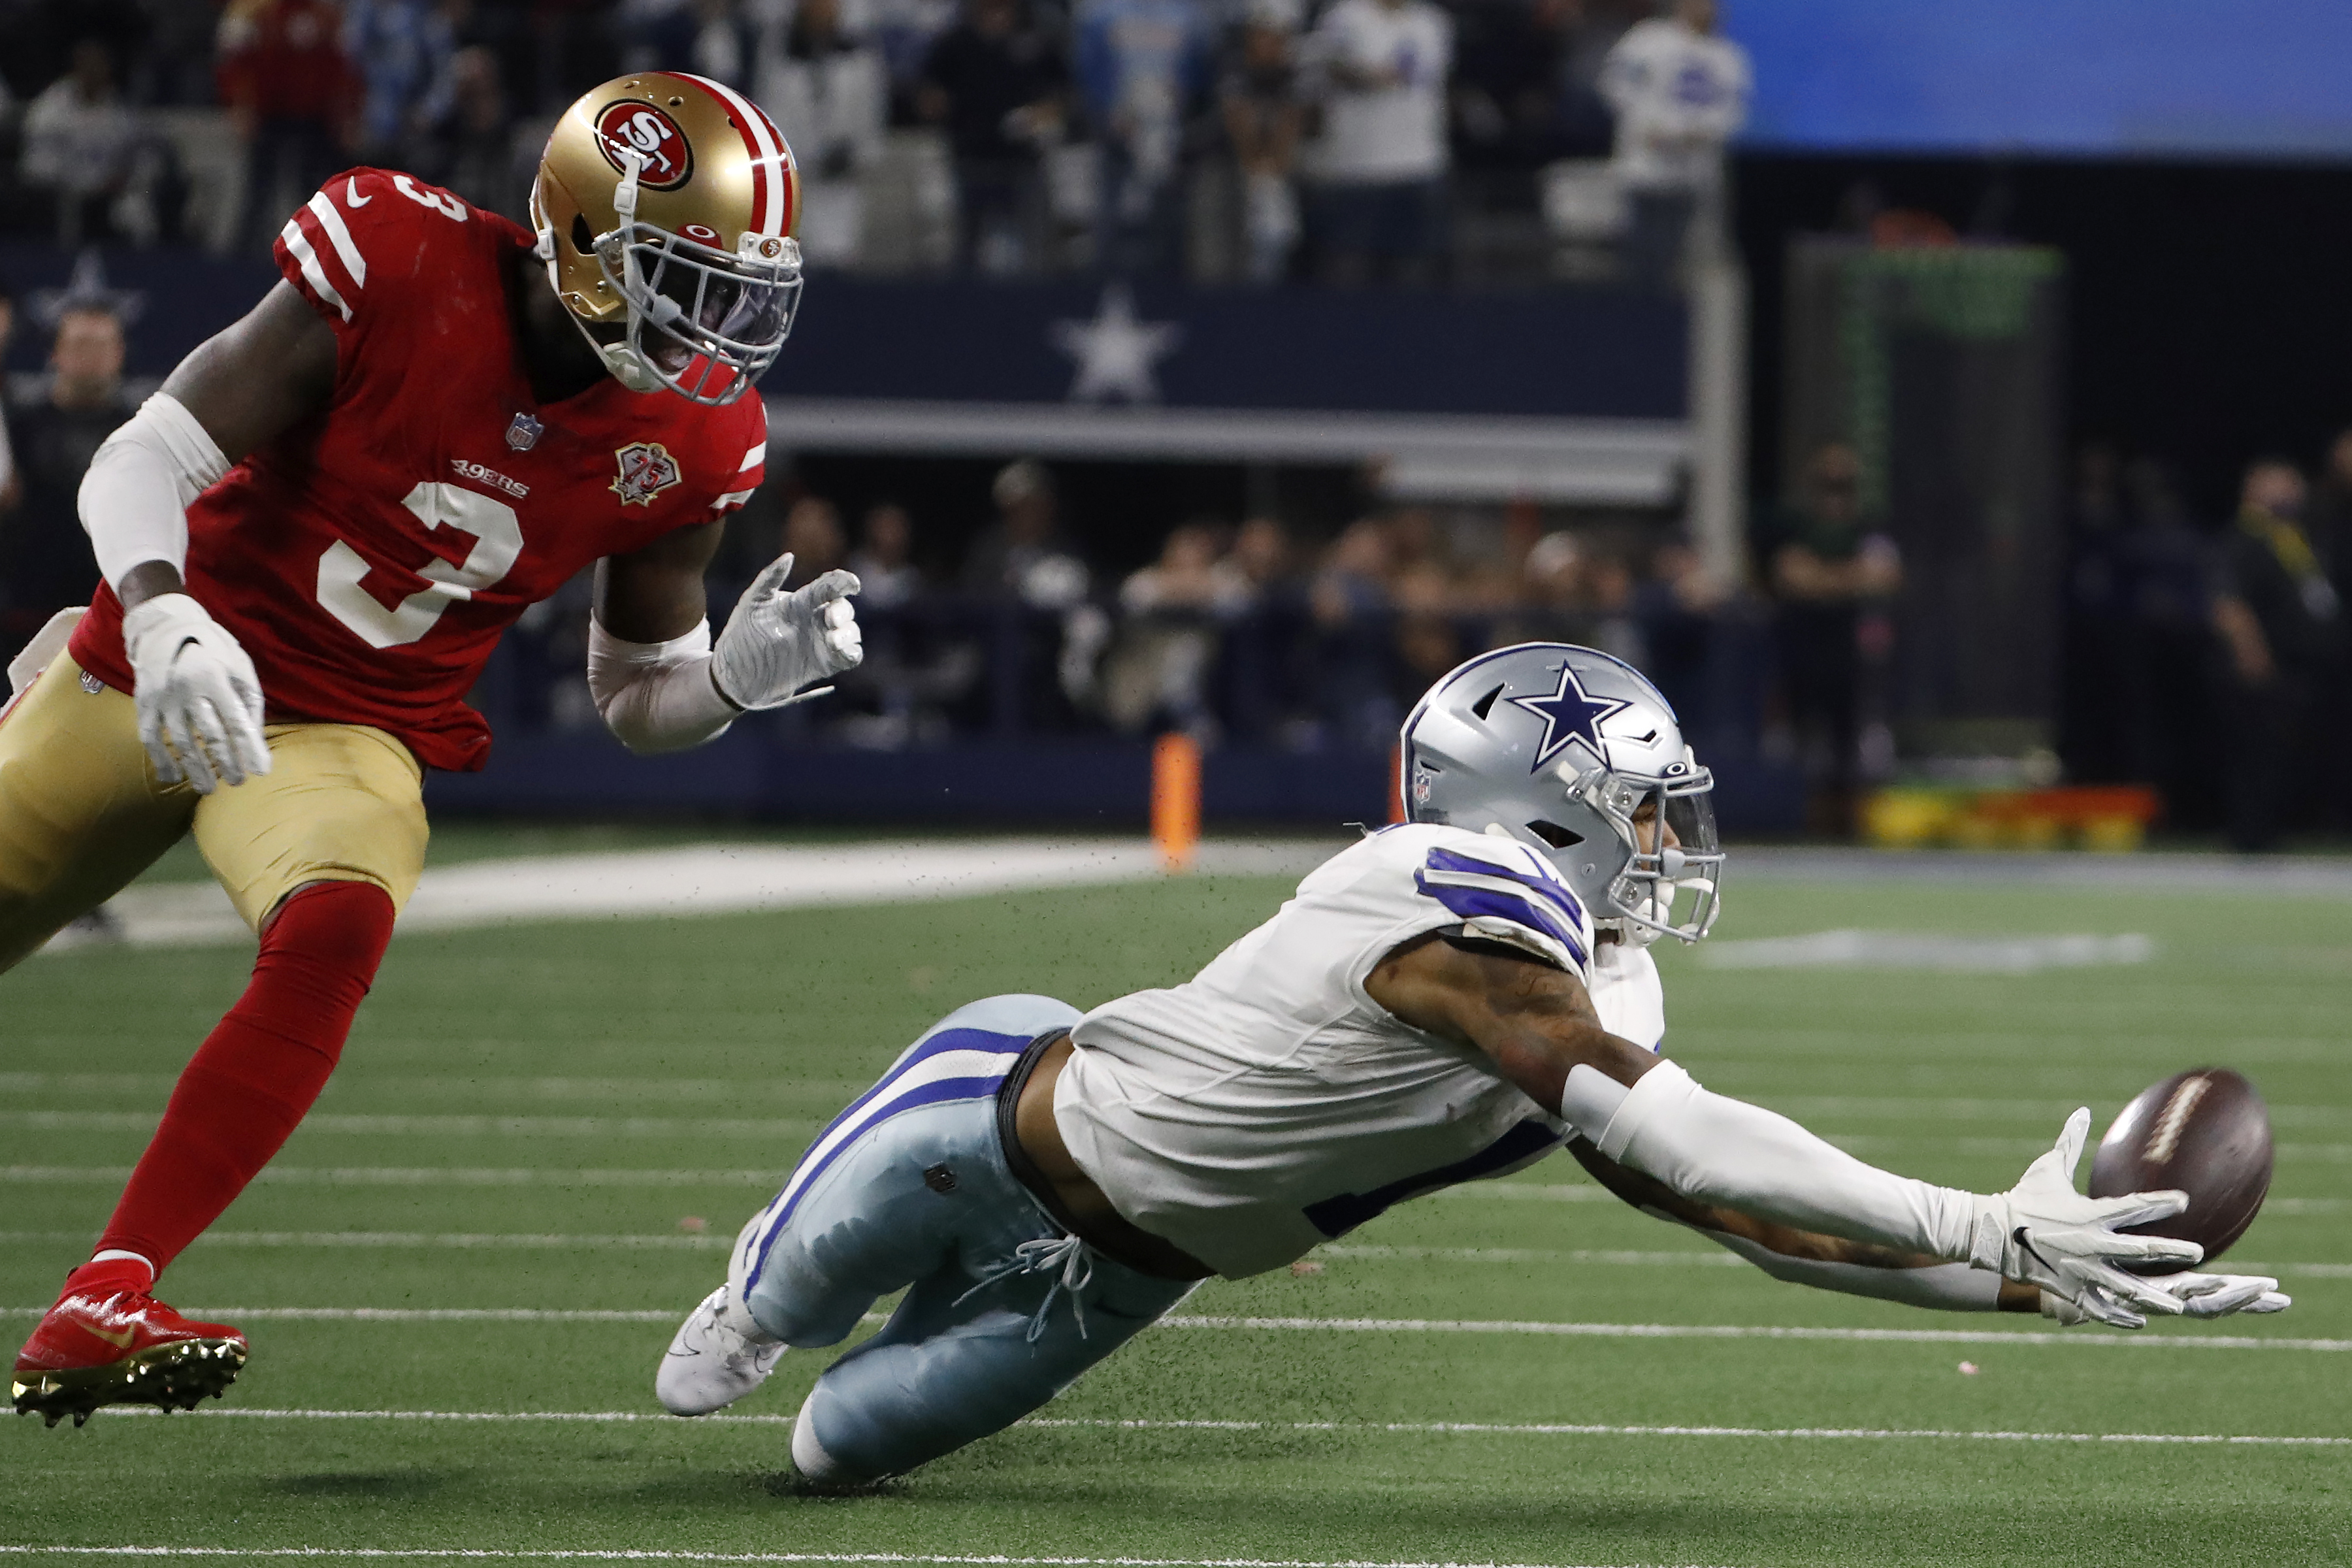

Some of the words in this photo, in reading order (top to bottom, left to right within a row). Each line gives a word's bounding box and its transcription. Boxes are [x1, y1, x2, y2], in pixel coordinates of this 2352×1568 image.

[393, 174, 468, 222] 3
[450, 459, 530, 498] 49ERS
[316, 481, 524, 649] 3
